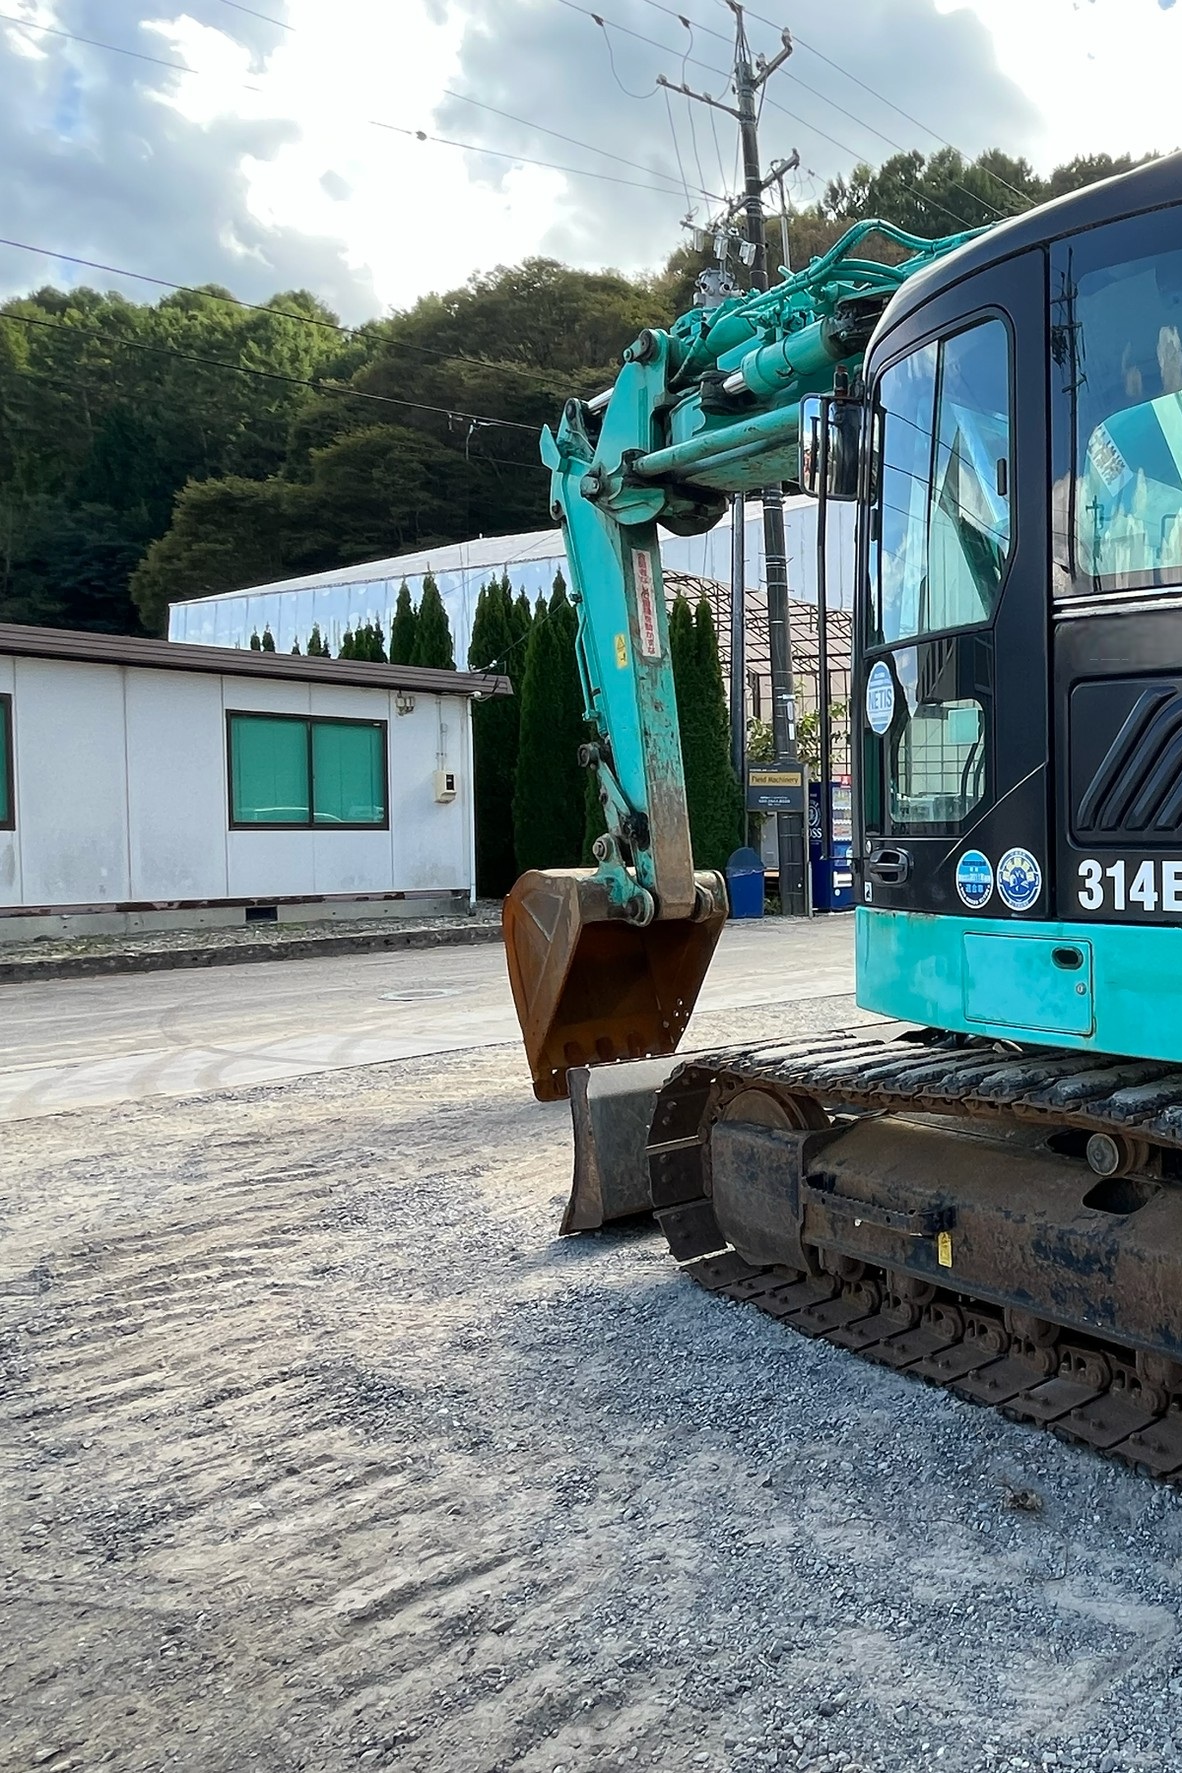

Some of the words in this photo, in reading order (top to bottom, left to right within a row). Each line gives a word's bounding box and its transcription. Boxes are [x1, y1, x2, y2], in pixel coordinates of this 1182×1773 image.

[868, 688, 893, 710] NETIS
[751, 775, 767, 783] Field
[768, 775, 799, 784] Machinery
